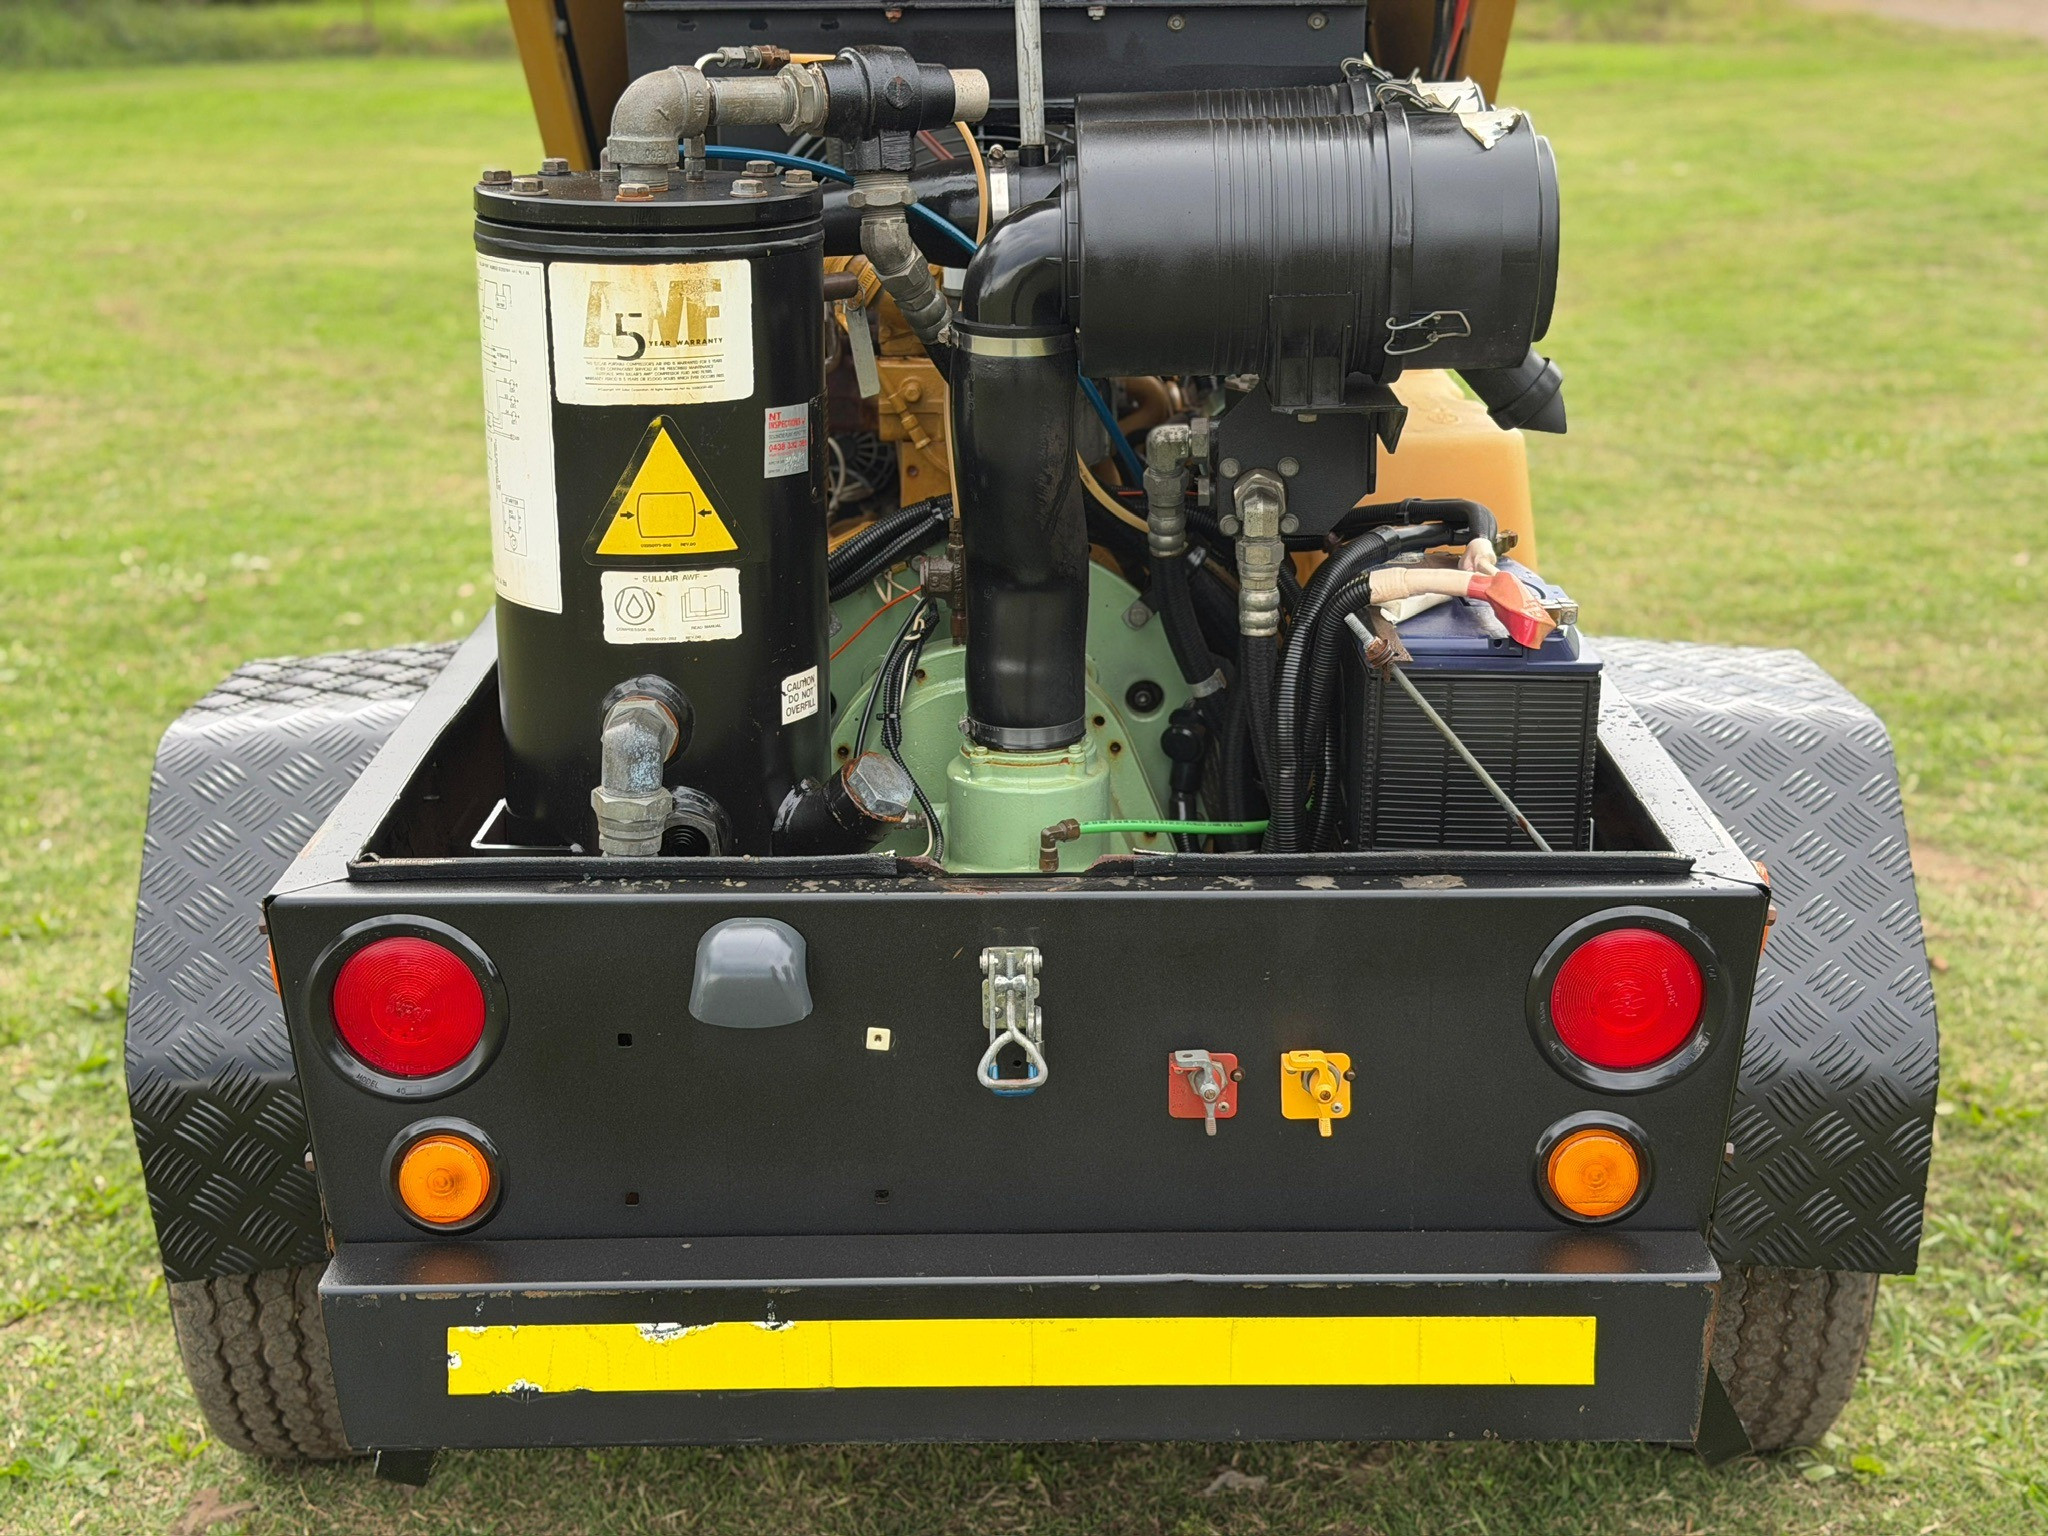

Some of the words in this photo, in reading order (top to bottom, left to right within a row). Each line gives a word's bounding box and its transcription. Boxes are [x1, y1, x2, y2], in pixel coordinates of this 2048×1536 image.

[615, 312, 646, 361] 5
[675, 337, 723, 346] WARRANTY
[768, 411, 782, 421] NT
[642, 574, 679, 583] SULLAIR
[682, 573, 700, 581] AWF
[786, 675, 815, 693] CAUTION
[788, 692, 800, 704] DO
[801, 686, 814, 700] NOT
[786, 697, 816, 718] OVERFILL
[356, 1073, 379, 1089] MODEL
[396, 1087, 406, 1095] 40
